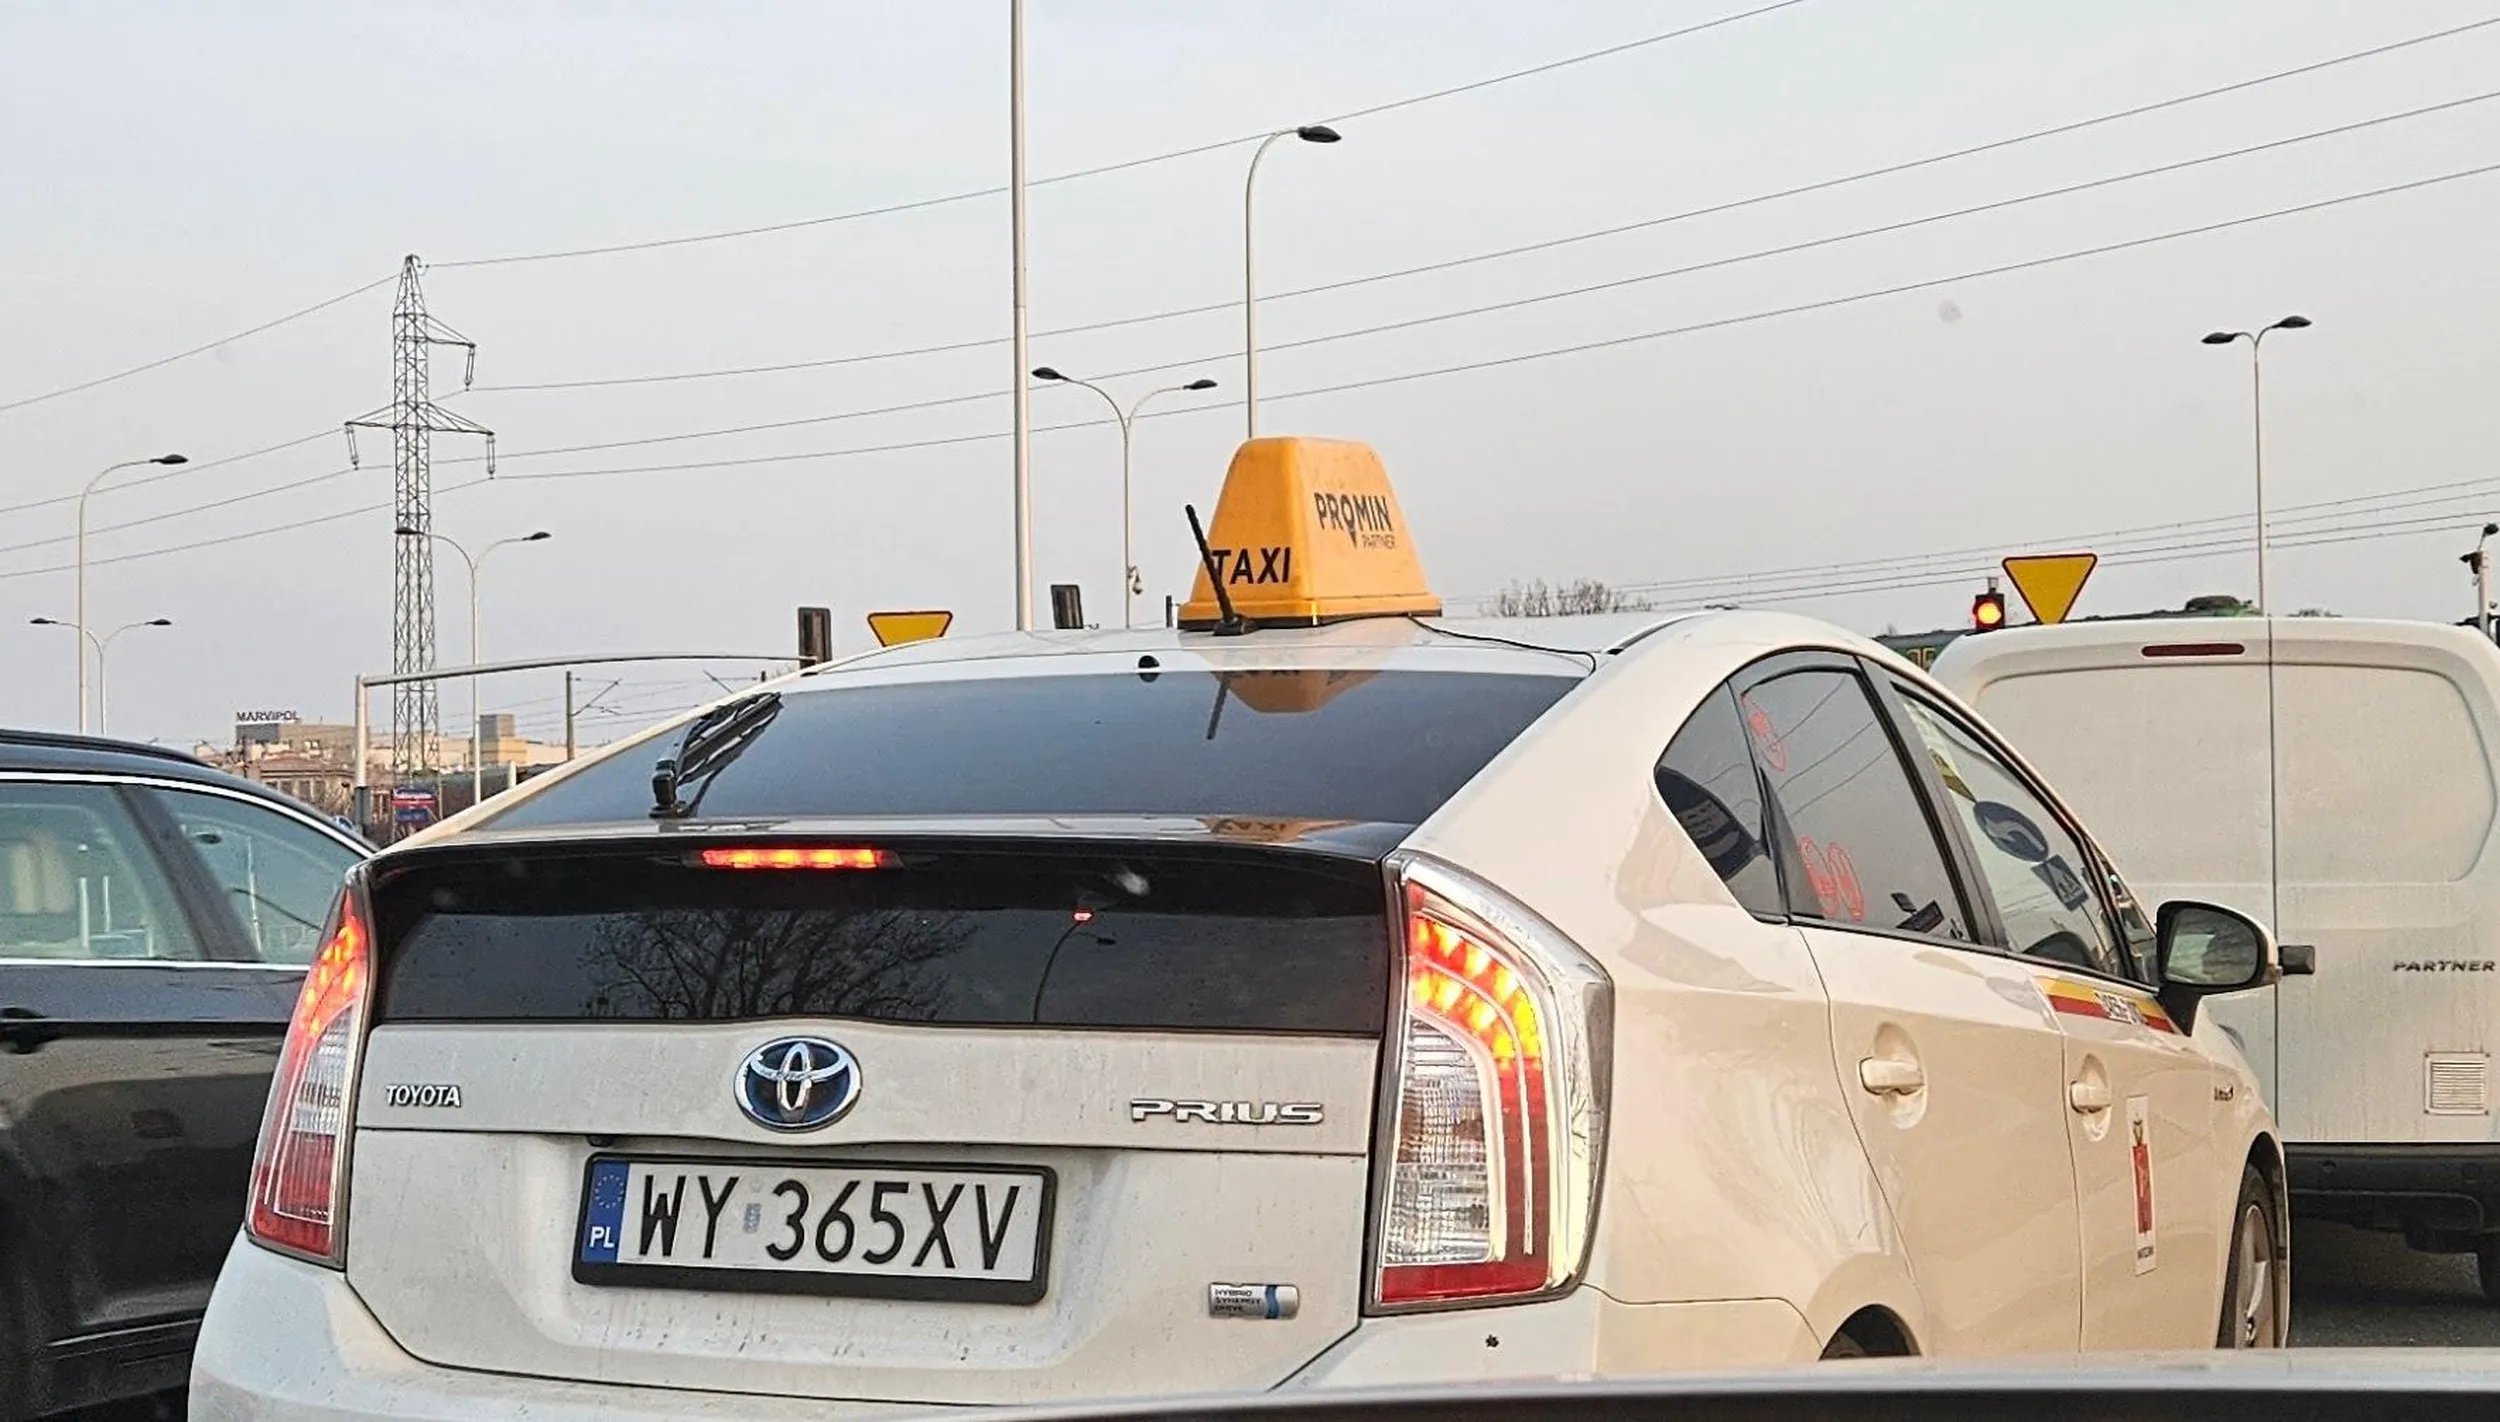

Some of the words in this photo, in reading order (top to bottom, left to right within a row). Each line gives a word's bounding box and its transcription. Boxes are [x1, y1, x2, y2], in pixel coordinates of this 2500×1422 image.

[1314, 491, 1393, 534] PROMIN
[1211, 547, 1292, 585] TAXI
[236, 710, 300, 722] MARVIPOL
[2391, 960, 2496, 973] PARTNER
[385, 1084, 462, 1108] TOYOTA
[1129, 1098, 1324, 1125] PRIUS
[638, 1174, 740, 1259] WY
[764, 1178, 1021, 1271] 365XV
[589, 1226, 615, 1249] PL
